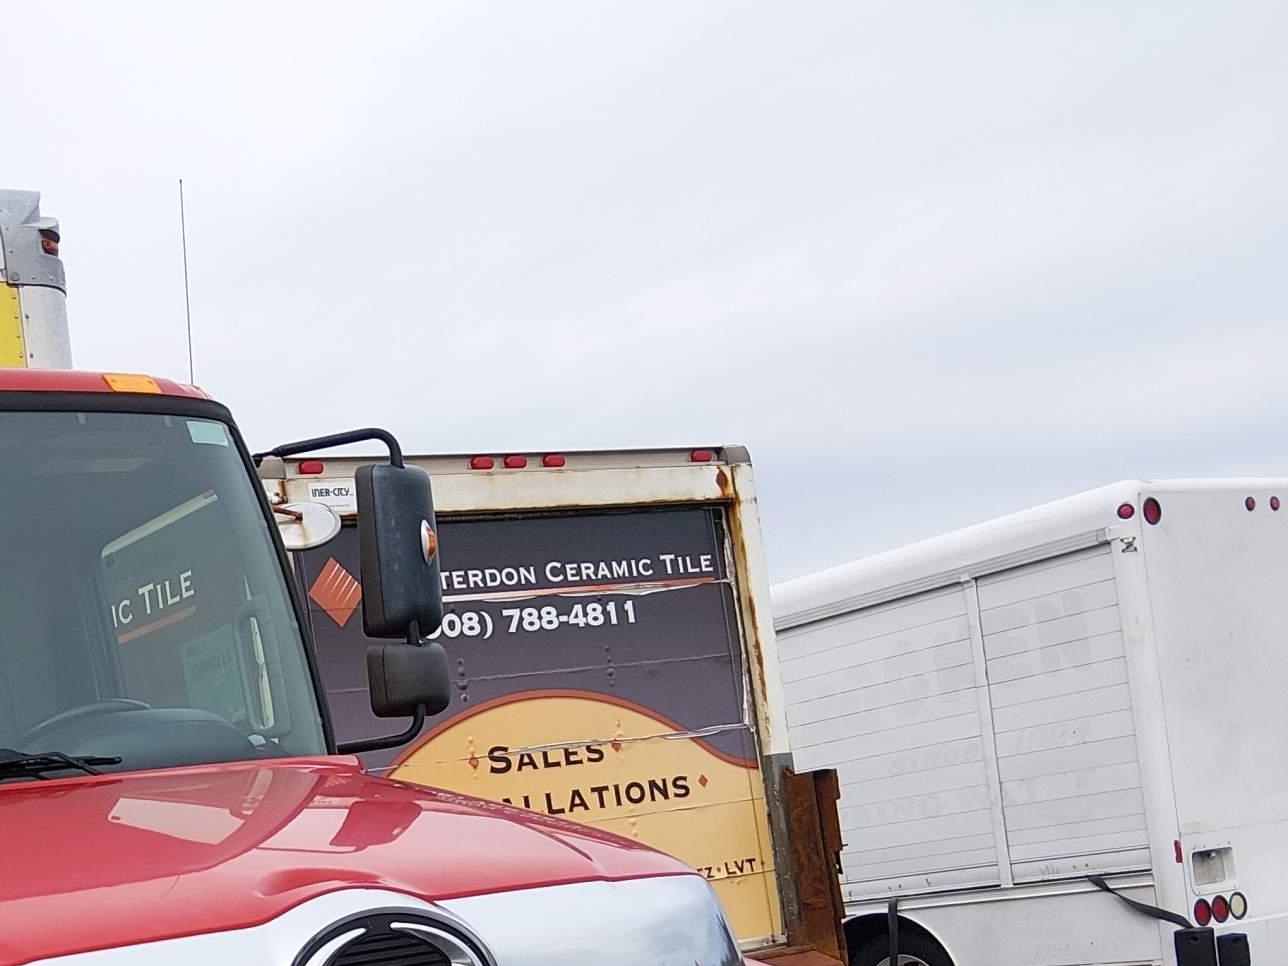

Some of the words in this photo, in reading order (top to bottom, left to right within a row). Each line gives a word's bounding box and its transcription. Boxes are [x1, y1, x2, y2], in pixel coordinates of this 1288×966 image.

[546, 558, 655, 581] CERAMIC
[660, 553, 715, 575] TILE
[138, 569, 195, 614] TILE
[426, 610, 493, 640] 08)
[502, 601, 637, 633] 788-4811
[488, 744, 605, 774] SALES
[502, 775, 690, 815] LATIONS
[724, 857, 756, 875] LVT
